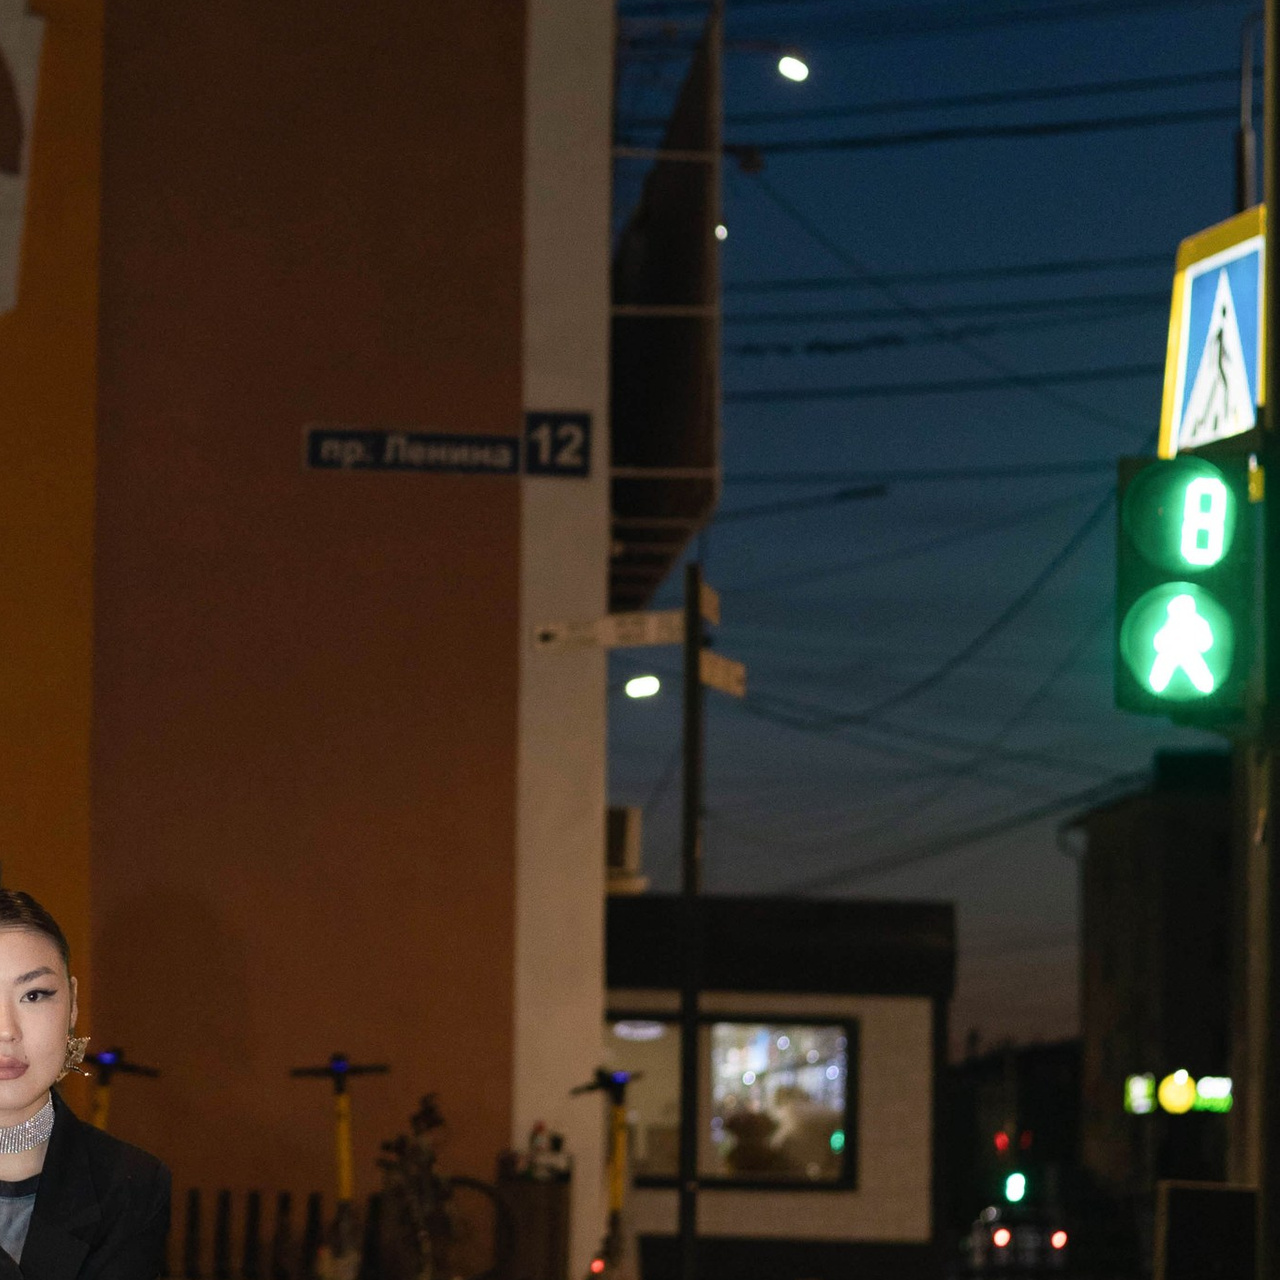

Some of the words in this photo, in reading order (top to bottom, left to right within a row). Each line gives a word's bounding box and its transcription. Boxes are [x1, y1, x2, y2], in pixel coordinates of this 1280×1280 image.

[384, 435, 512, 468] Ленина
[531, 423, 584, 467] 12
[1180, 477, 1227, 566] 8
